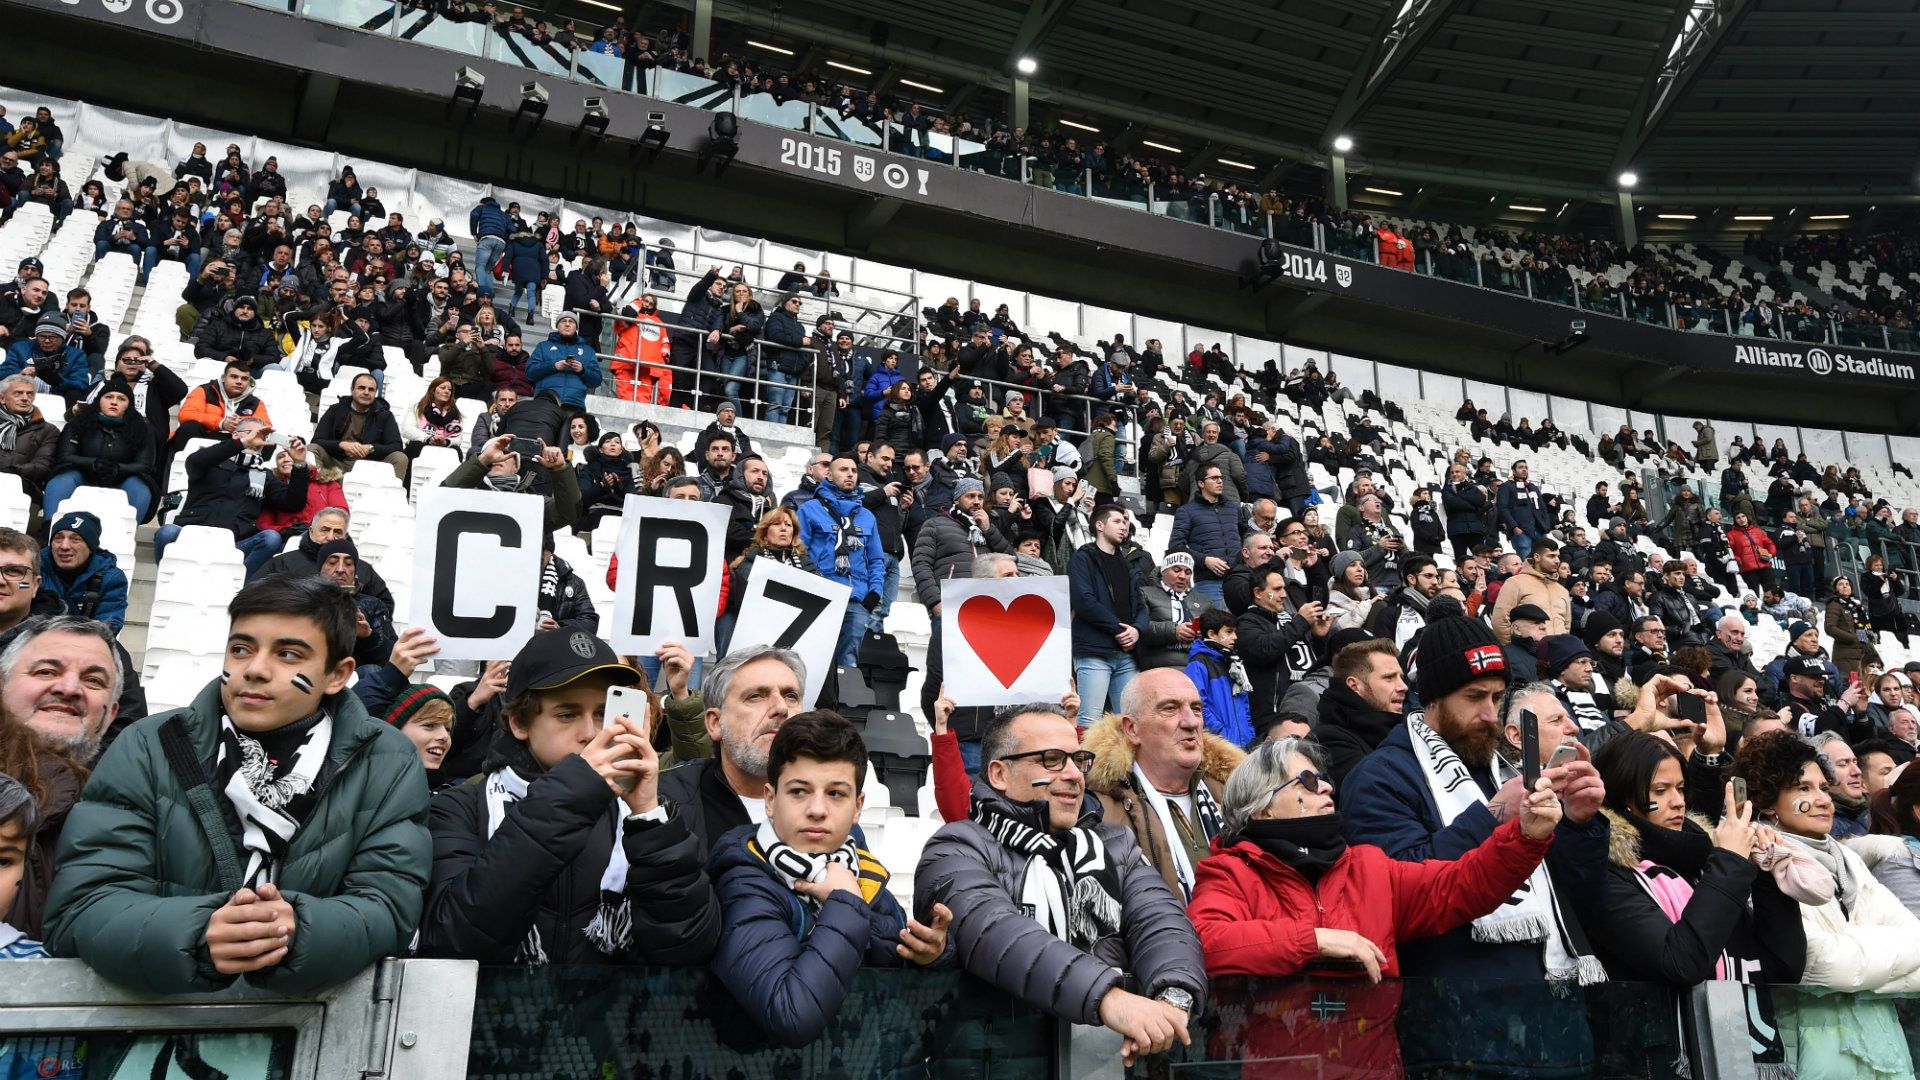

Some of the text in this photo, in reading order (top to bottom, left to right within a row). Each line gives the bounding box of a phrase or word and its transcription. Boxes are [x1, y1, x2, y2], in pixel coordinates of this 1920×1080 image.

[781, 138, 841, 175] 2015
[856, 160, 872, 175] 33
[1281, 253, 1327, 282] 2014
[1337, 268, 1350, 282] 32
[1735, 345, 1915, 380] Allianz Stadium
[431, 511, 522, 639] C
[631, 516, 709, 638] R
[762, 579, 832, 649] 7
